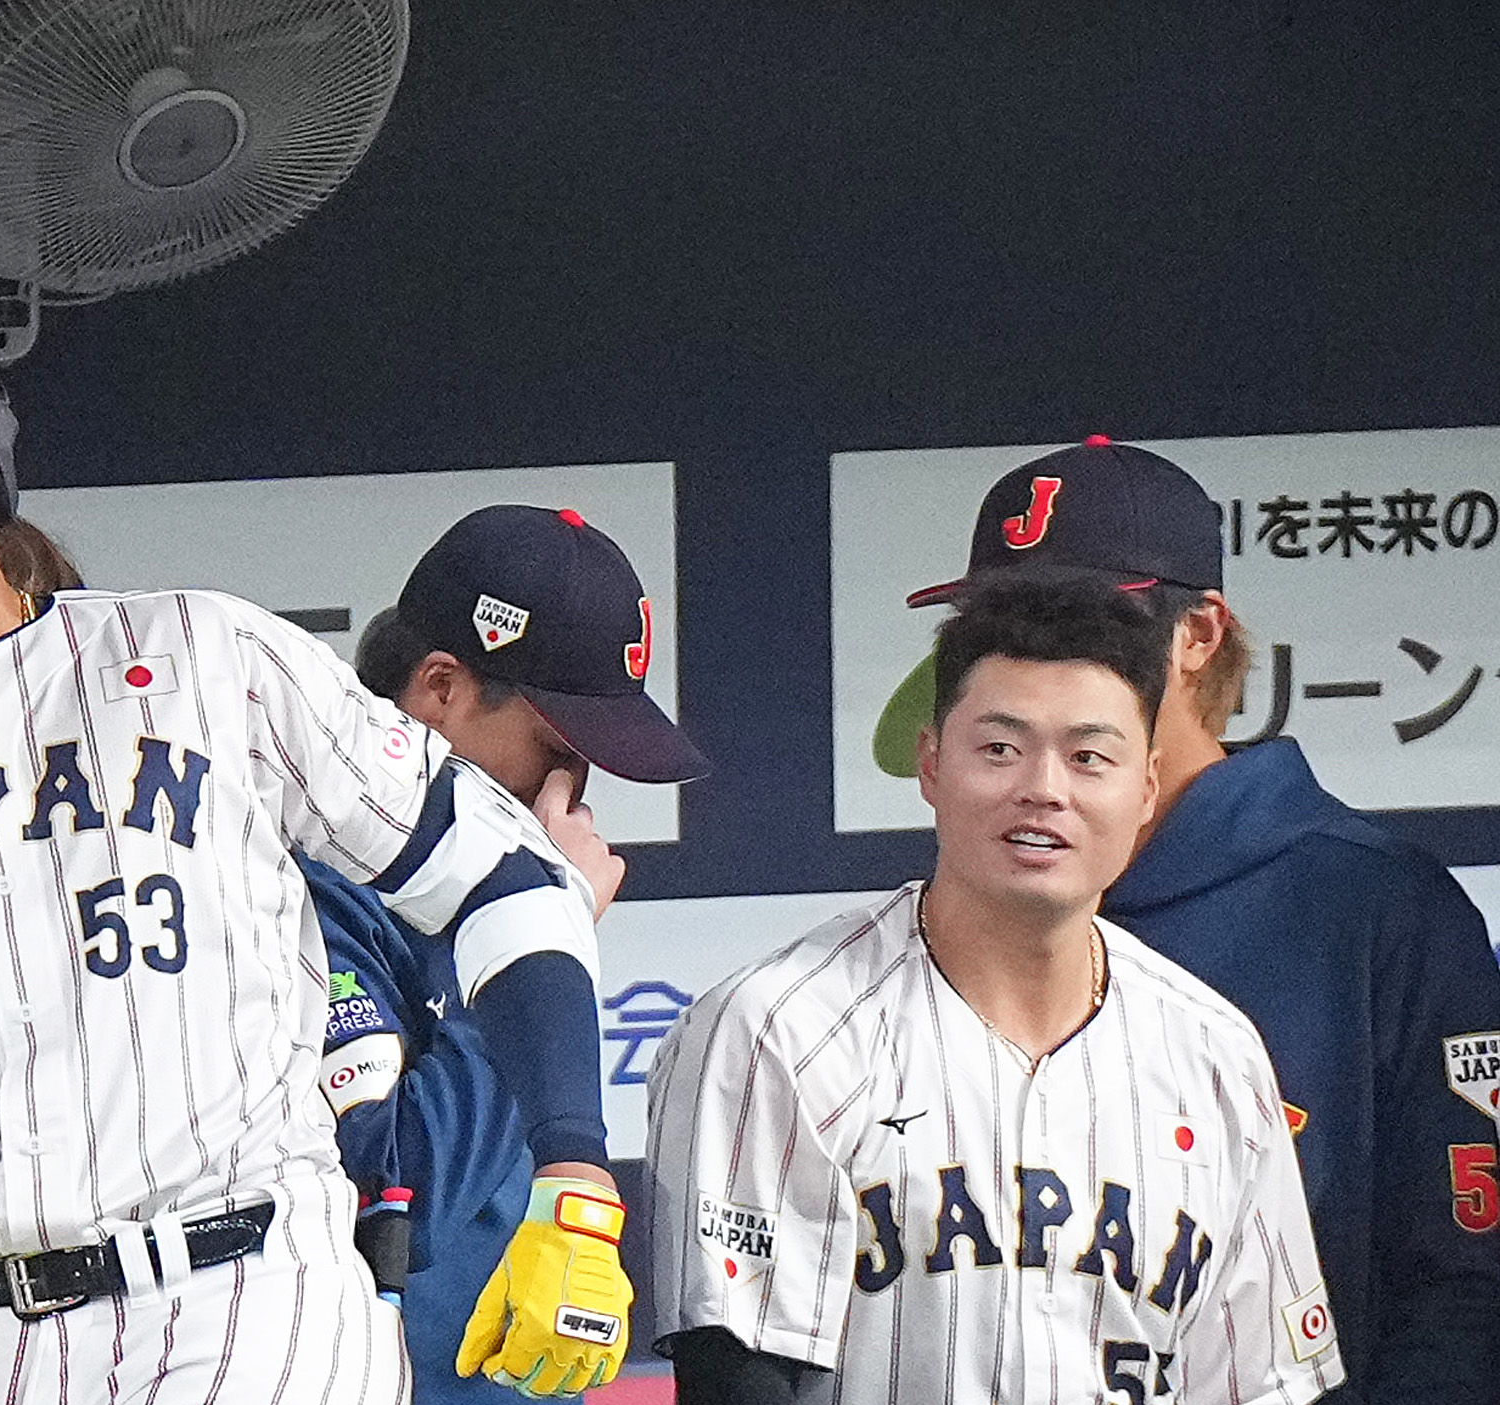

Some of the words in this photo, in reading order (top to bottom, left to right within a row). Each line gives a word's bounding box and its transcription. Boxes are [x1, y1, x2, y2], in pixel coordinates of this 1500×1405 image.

[1002, 476, 1063, 551] J
[476, 608, 521, 634] JAPAN
[624, 597, 652, 681] J
[1218, 636, 1500, 750] リーン
[74, 872, 189, 980] 53
[325, 1011, 384, 1037] PRESS
[700, 1217, 774, 1259] JAPAN
[702, 1200, 778, 1233] SAMURAI
[854, 1162, 1214, 1314] JAPAN
